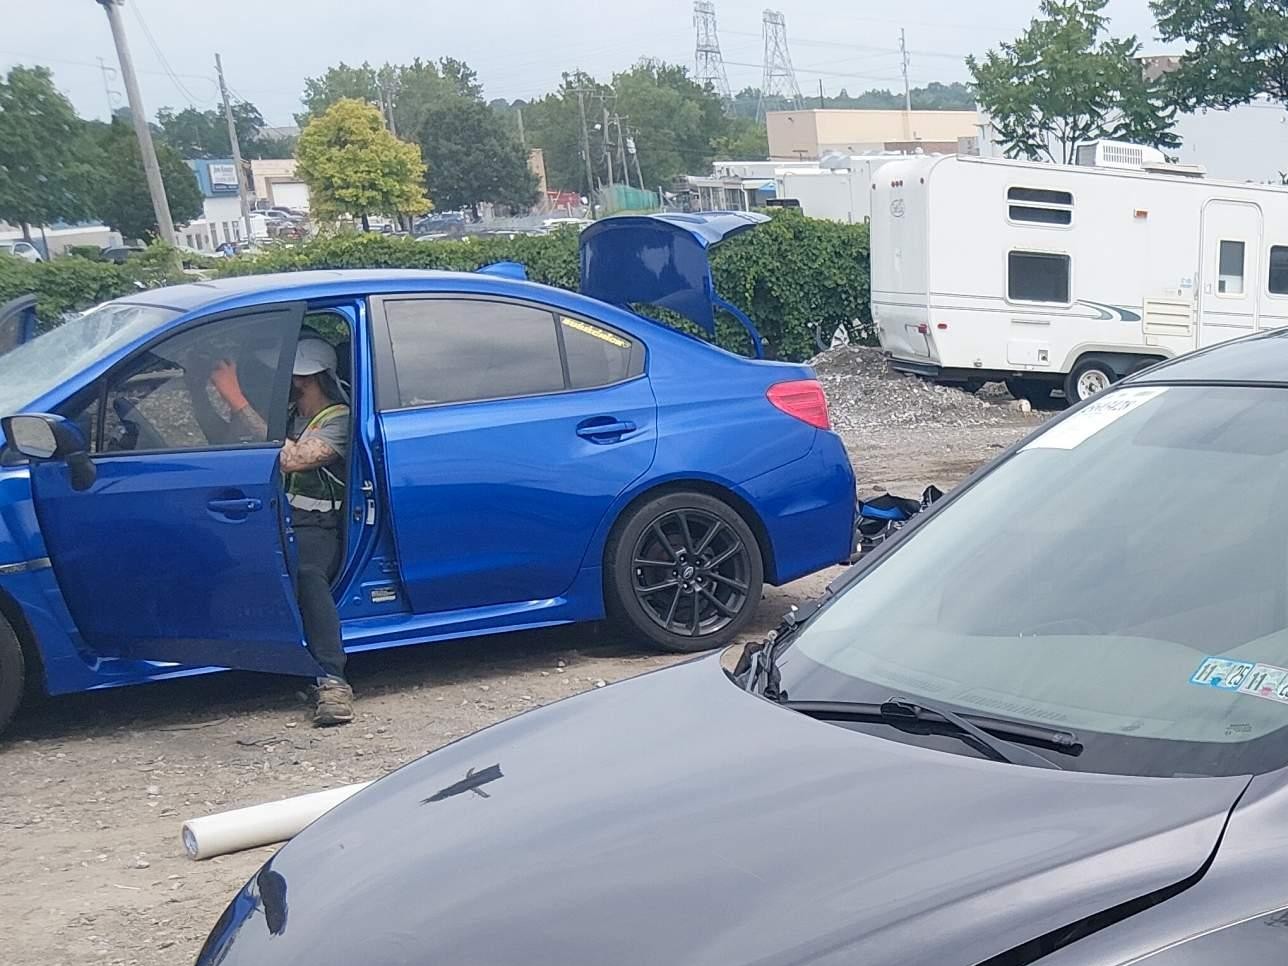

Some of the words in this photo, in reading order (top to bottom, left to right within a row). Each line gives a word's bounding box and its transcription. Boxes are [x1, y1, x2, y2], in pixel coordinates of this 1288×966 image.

[1196, 663, 1218, 681] 11
[1228, 665, 1250, 685] 25
[1246, 671, 1268, 691] 11
